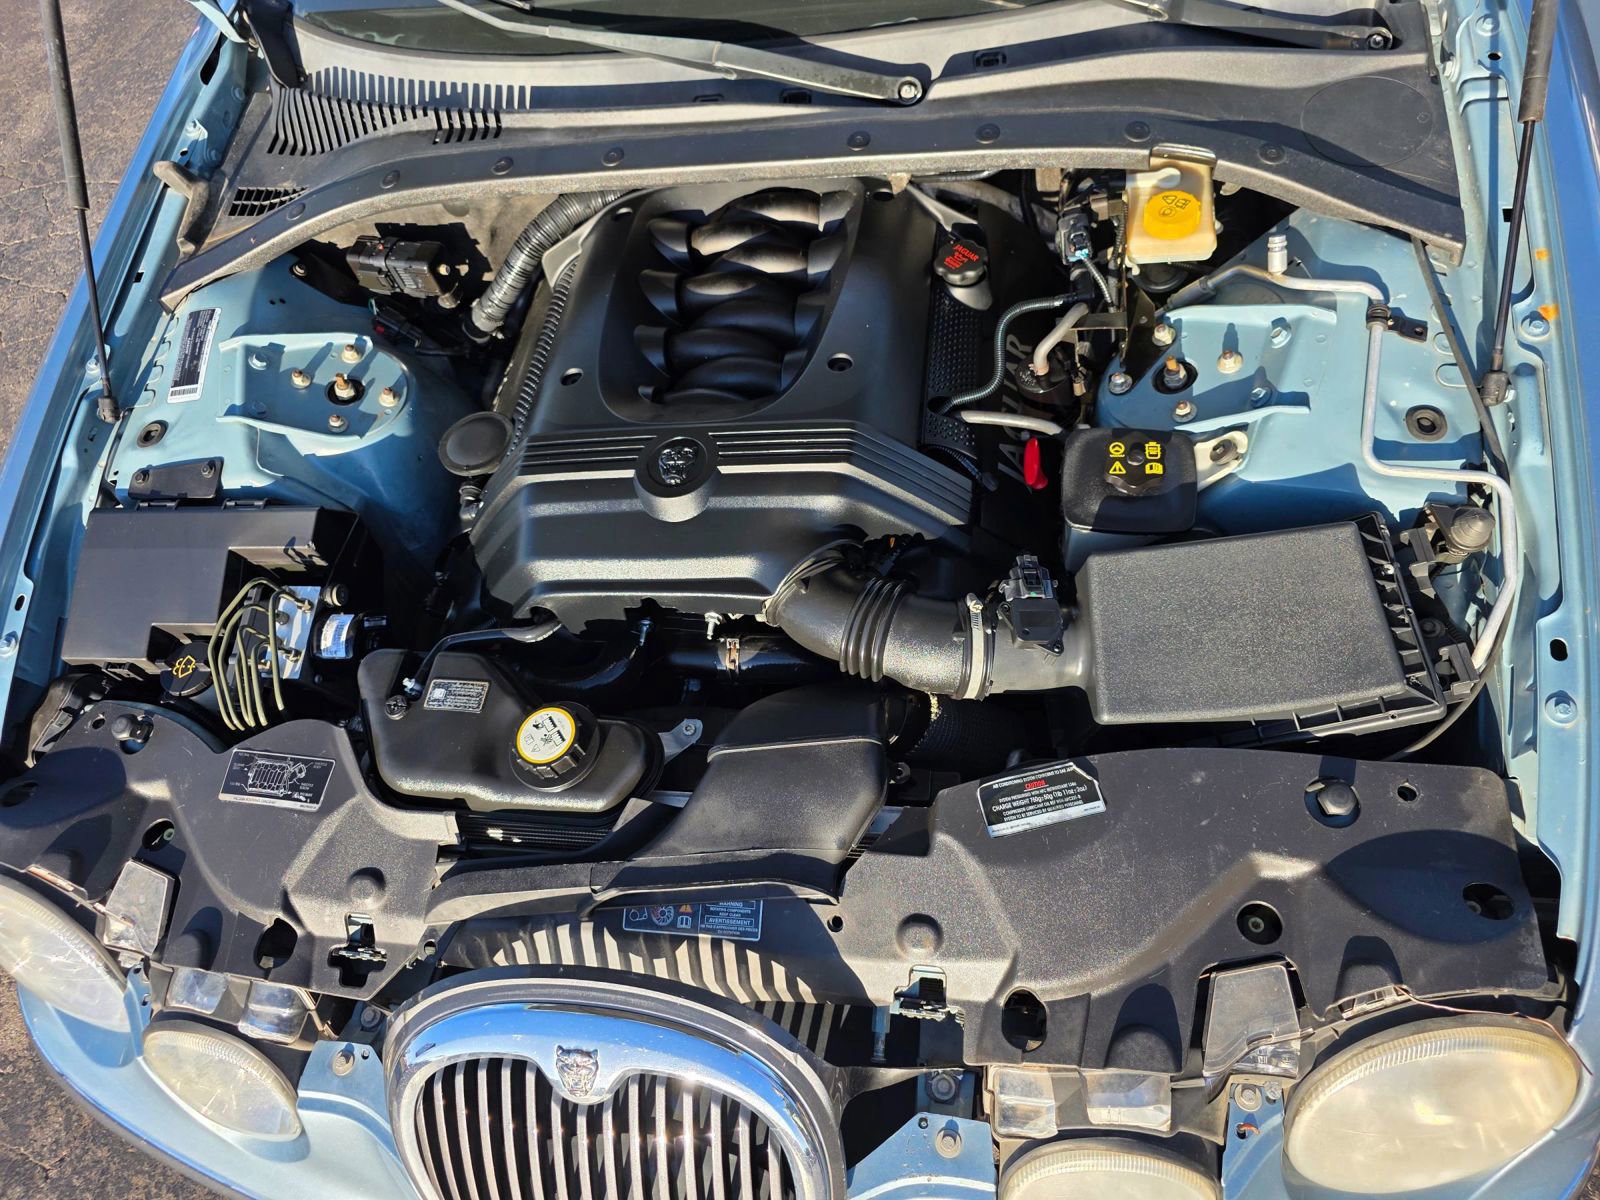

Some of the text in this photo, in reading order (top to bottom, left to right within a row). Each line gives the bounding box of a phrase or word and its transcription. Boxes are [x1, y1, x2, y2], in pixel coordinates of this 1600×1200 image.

[953, 244, 979, 262] JAGUAR
[999, 779, 1023, 787] CONDITIONING
[1024, 780, 1046, 789] CAUTION
[992, 802, 1012, 812] CHARGE
[1012, 798, 1030, 807] WEIGHT
